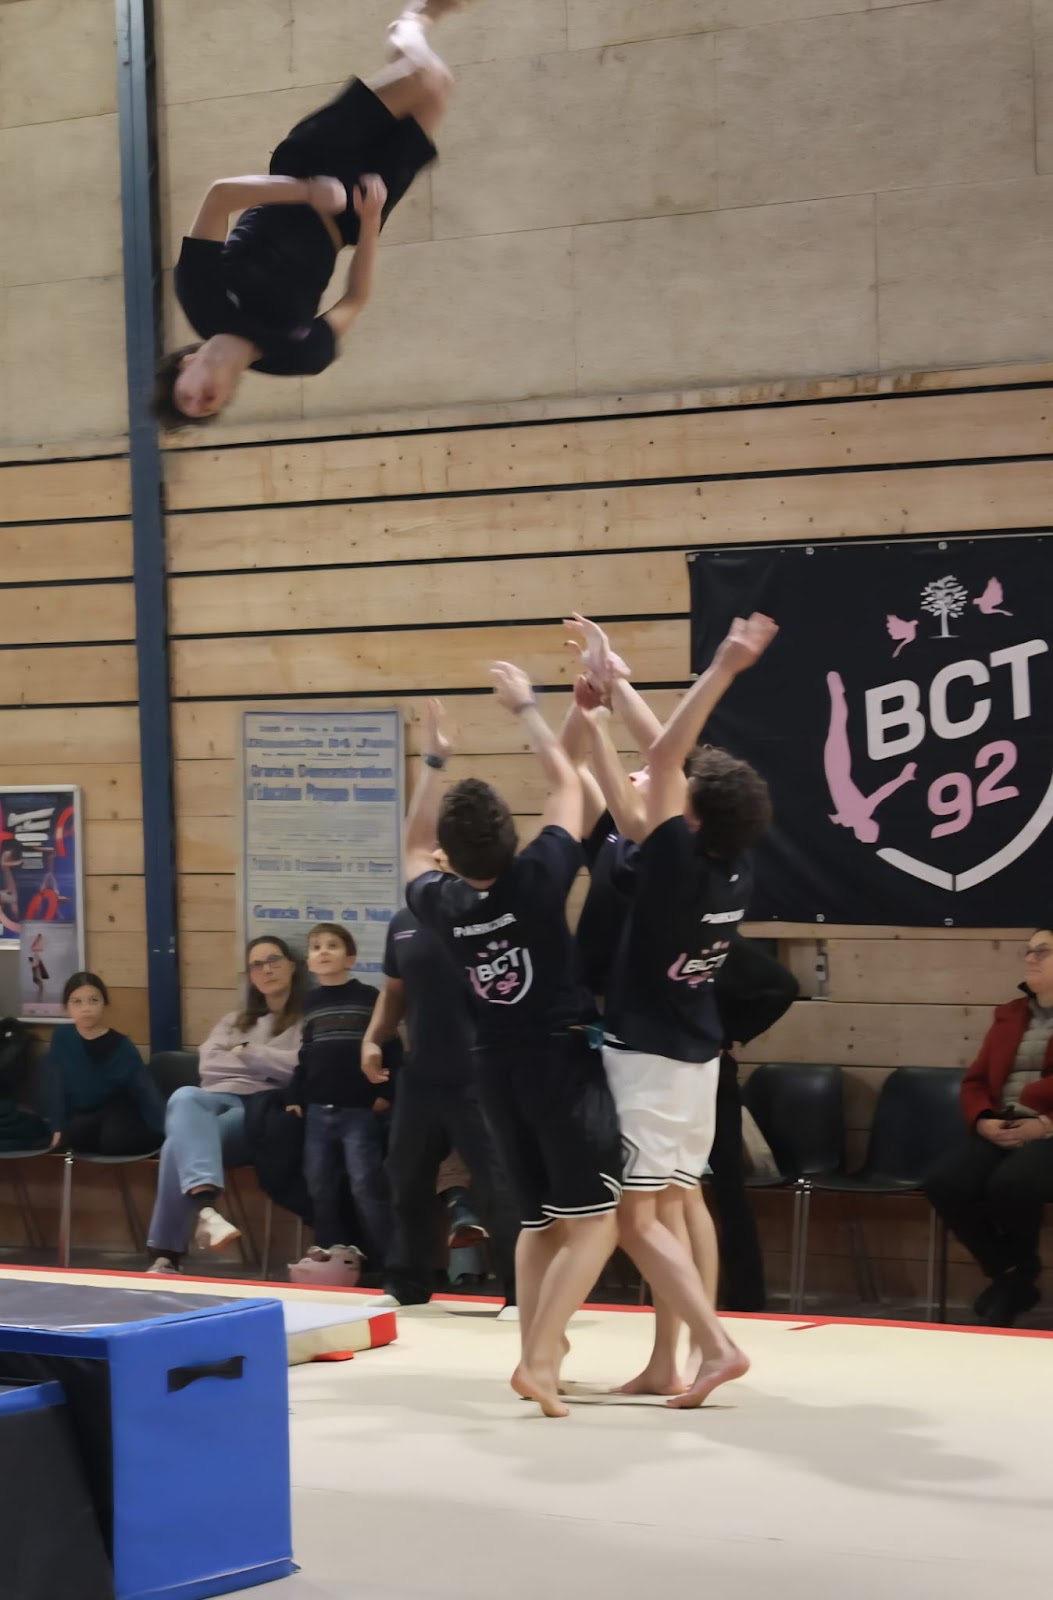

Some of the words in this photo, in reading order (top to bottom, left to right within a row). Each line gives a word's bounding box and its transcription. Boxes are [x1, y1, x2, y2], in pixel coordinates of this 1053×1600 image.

[864, 638, 1049, 761] BCT
[927, 739, 1020, 839] 92
[476, 946, 521, 982] BCT
[681, 952, 729, 974] BCT
